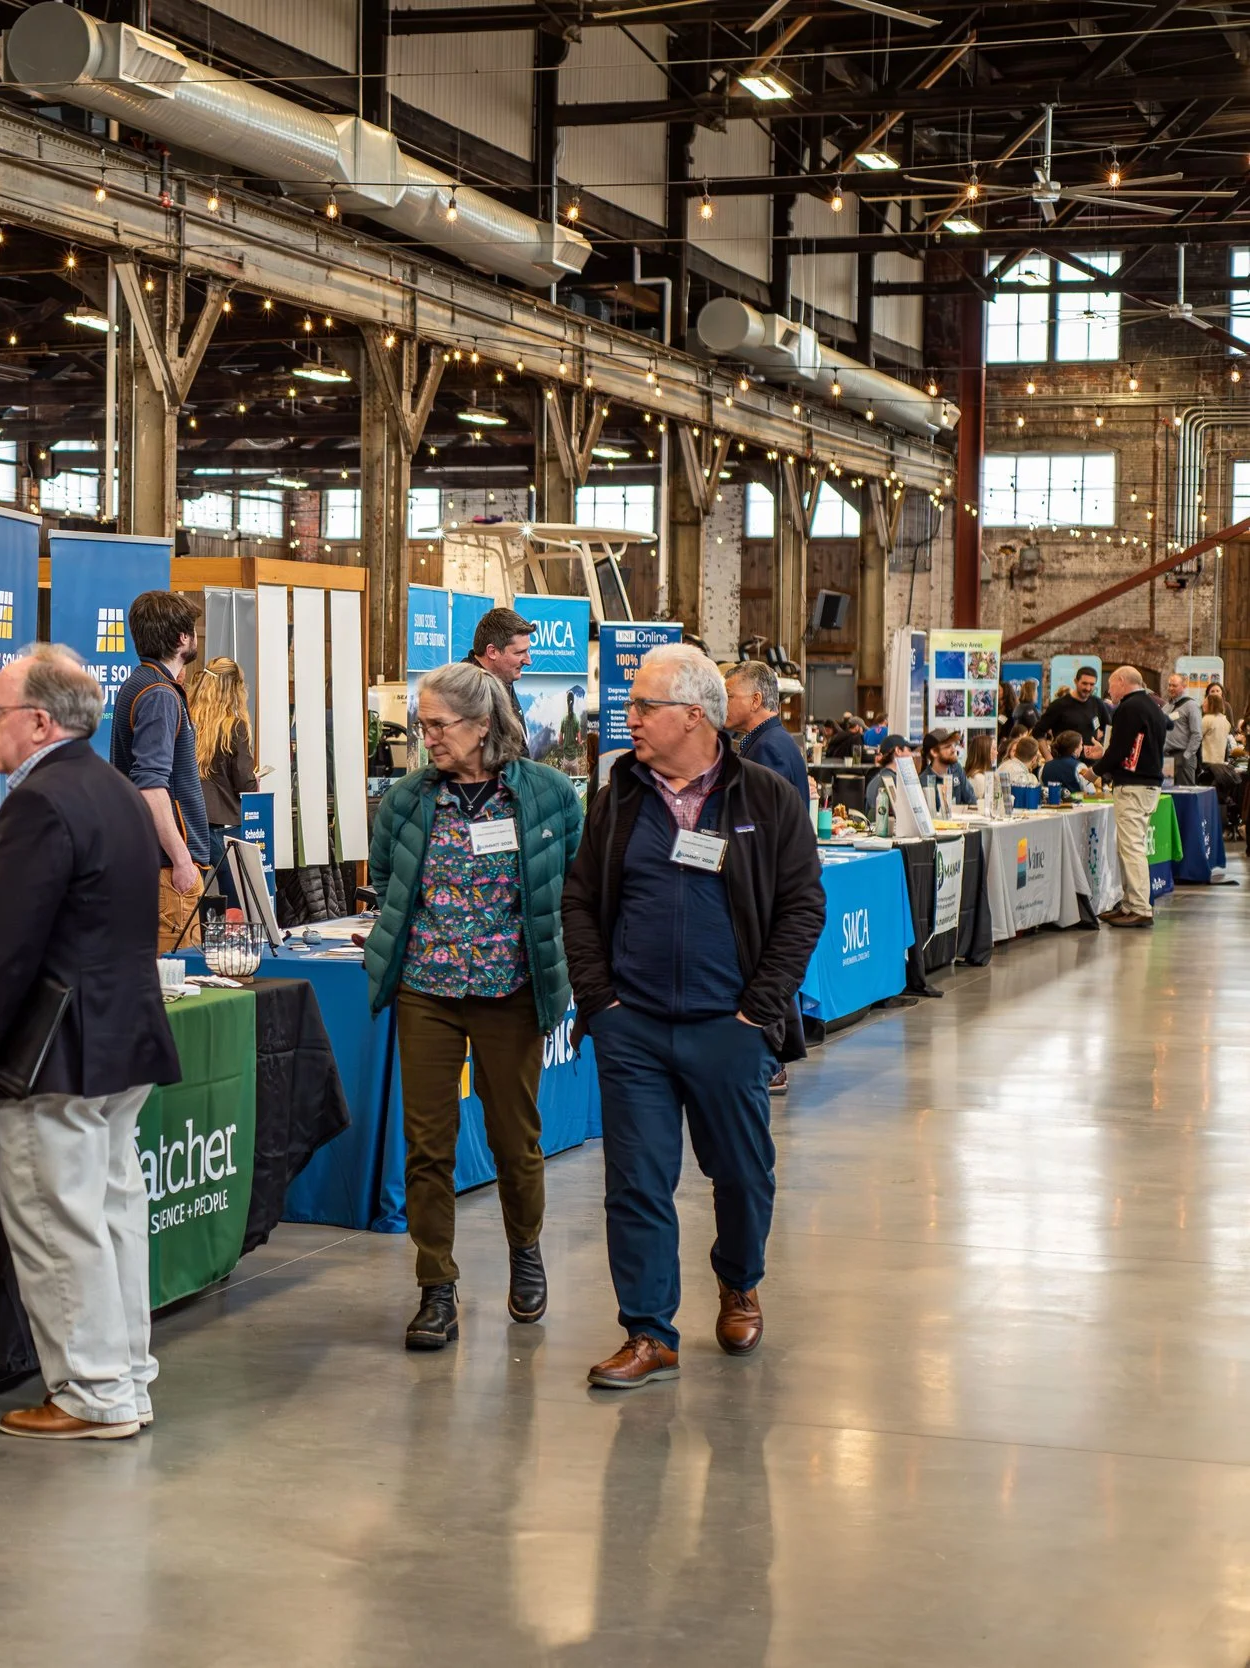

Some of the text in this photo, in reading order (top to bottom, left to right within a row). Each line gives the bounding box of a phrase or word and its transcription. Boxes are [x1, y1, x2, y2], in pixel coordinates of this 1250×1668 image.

[530, 620, 575, 648] SWCA
[637, 631, 668, 643] Online
[950, 641, 968, 649] Service
[616, 654, 638, 666] 100%
[245, 829, 265, 840] Schedule
[842, 908, 870, 954] SWCA
[136, 1119, 237, 1201] atcher
[187, 1204, 192, 1218] +
[194, 1189, 228, 1218] PEOPLE
